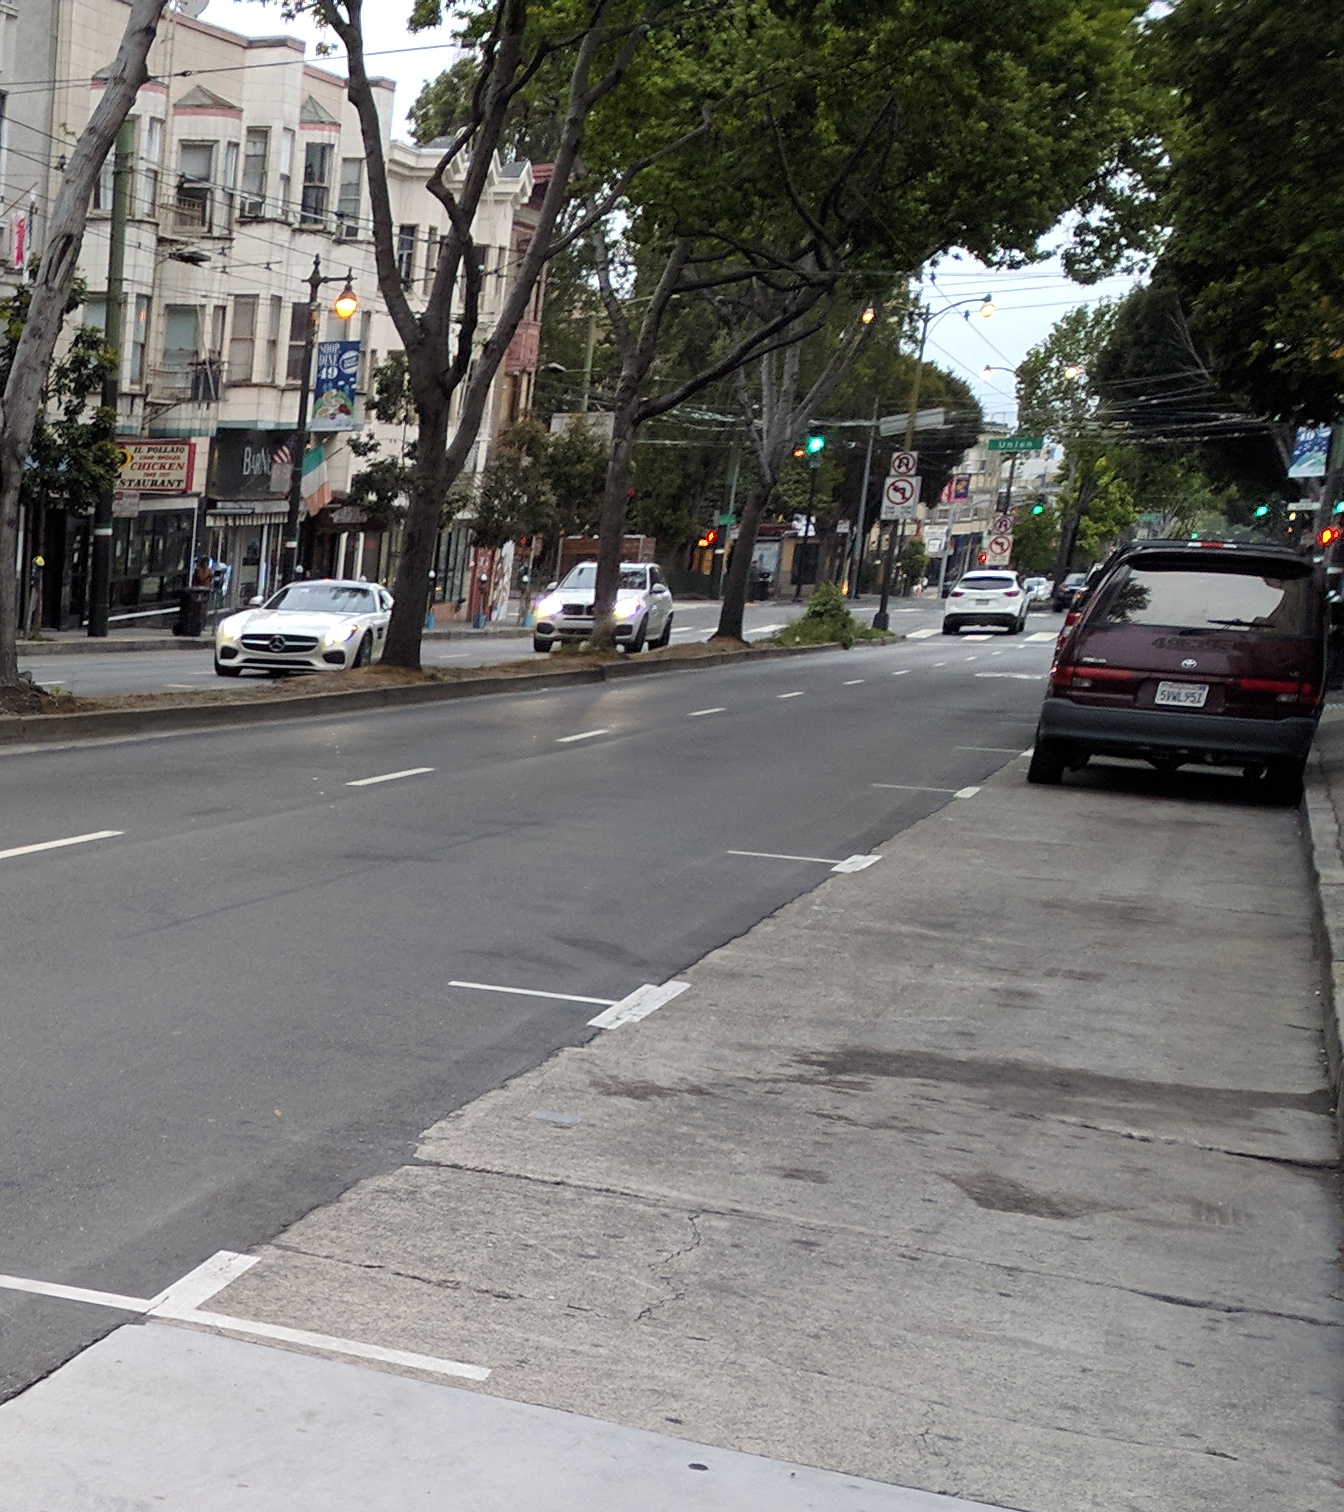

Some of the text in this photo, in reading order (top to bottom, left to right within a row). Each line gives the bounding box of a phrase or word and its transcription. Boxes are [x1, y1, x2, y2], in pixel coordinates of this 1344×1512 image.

[998, 440, 1033, 449] Union
[147, 446, 186, 454] POLLAIO
[130, 462, 186, 471] CHICKEN
[118, 479, 185, 488] STAURANT
